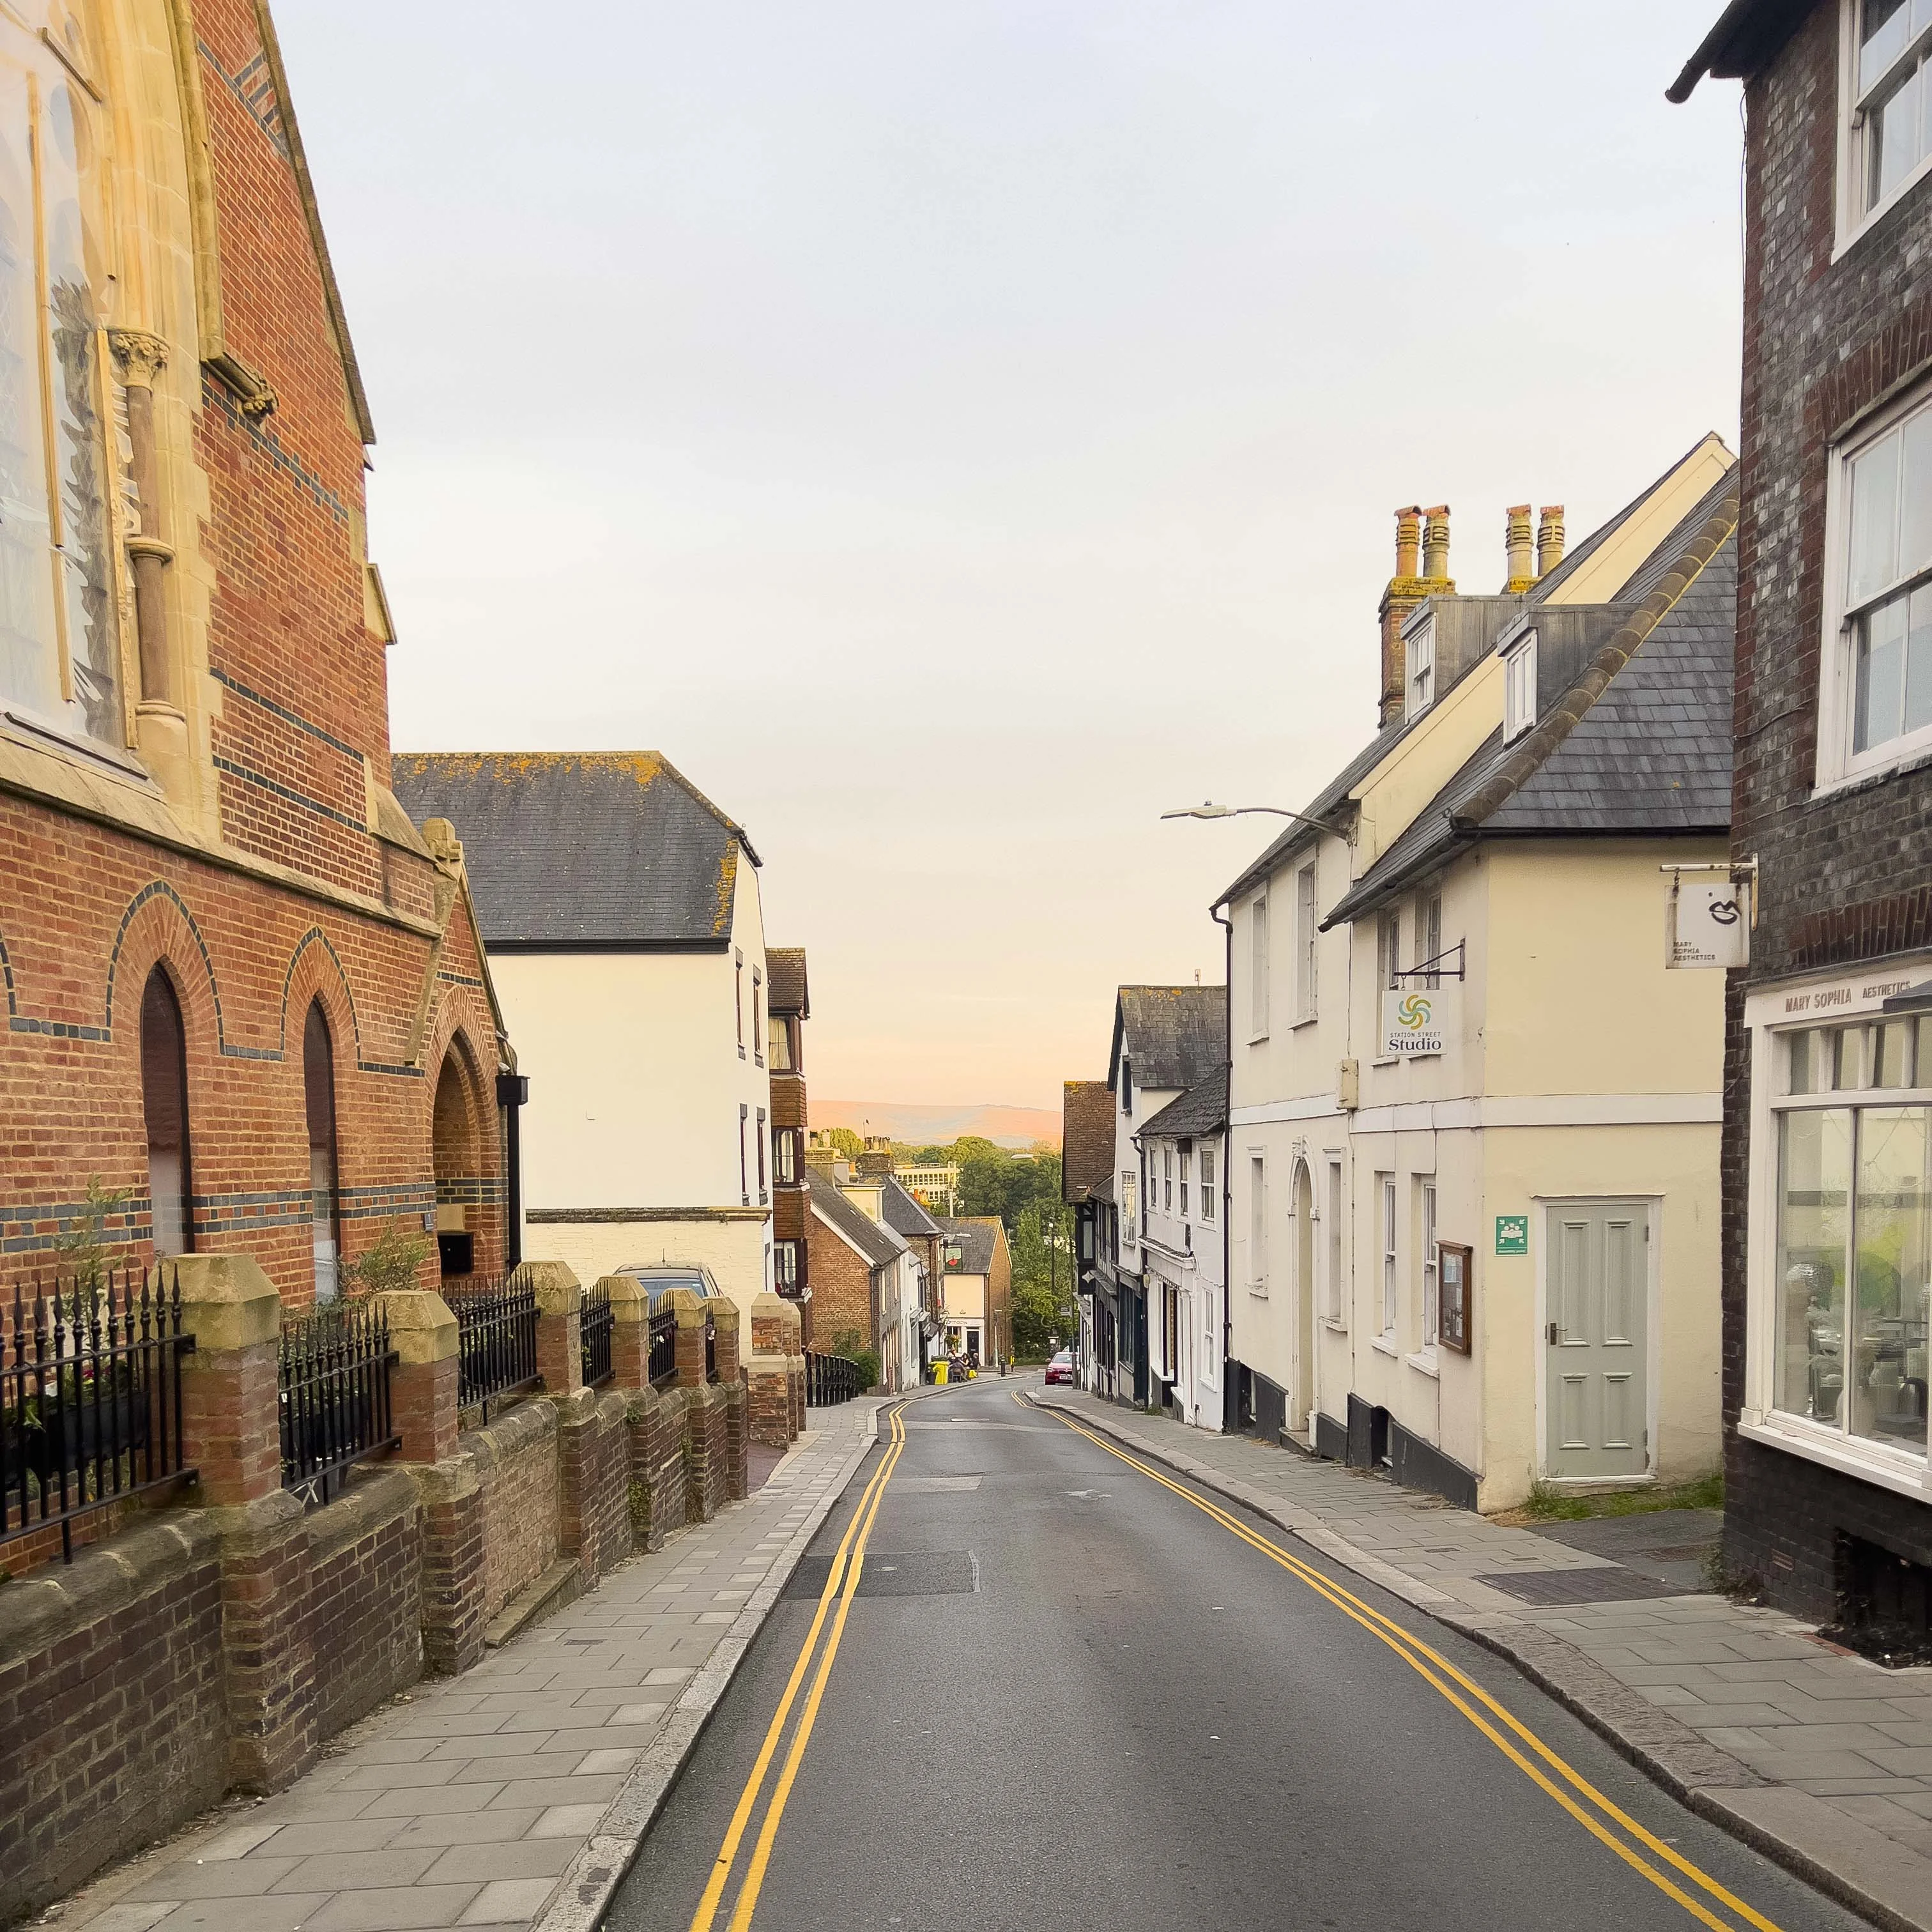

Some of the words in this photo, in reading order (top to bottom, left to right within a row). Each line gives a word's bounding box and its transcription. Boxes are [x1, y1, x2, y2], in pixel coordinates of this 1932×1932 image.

[1785, 995, 1811, 1013] MARY
[1814, 988, 1852, 1009] SOPHIA
[1388, 1038, 1442, 1051] Studio
